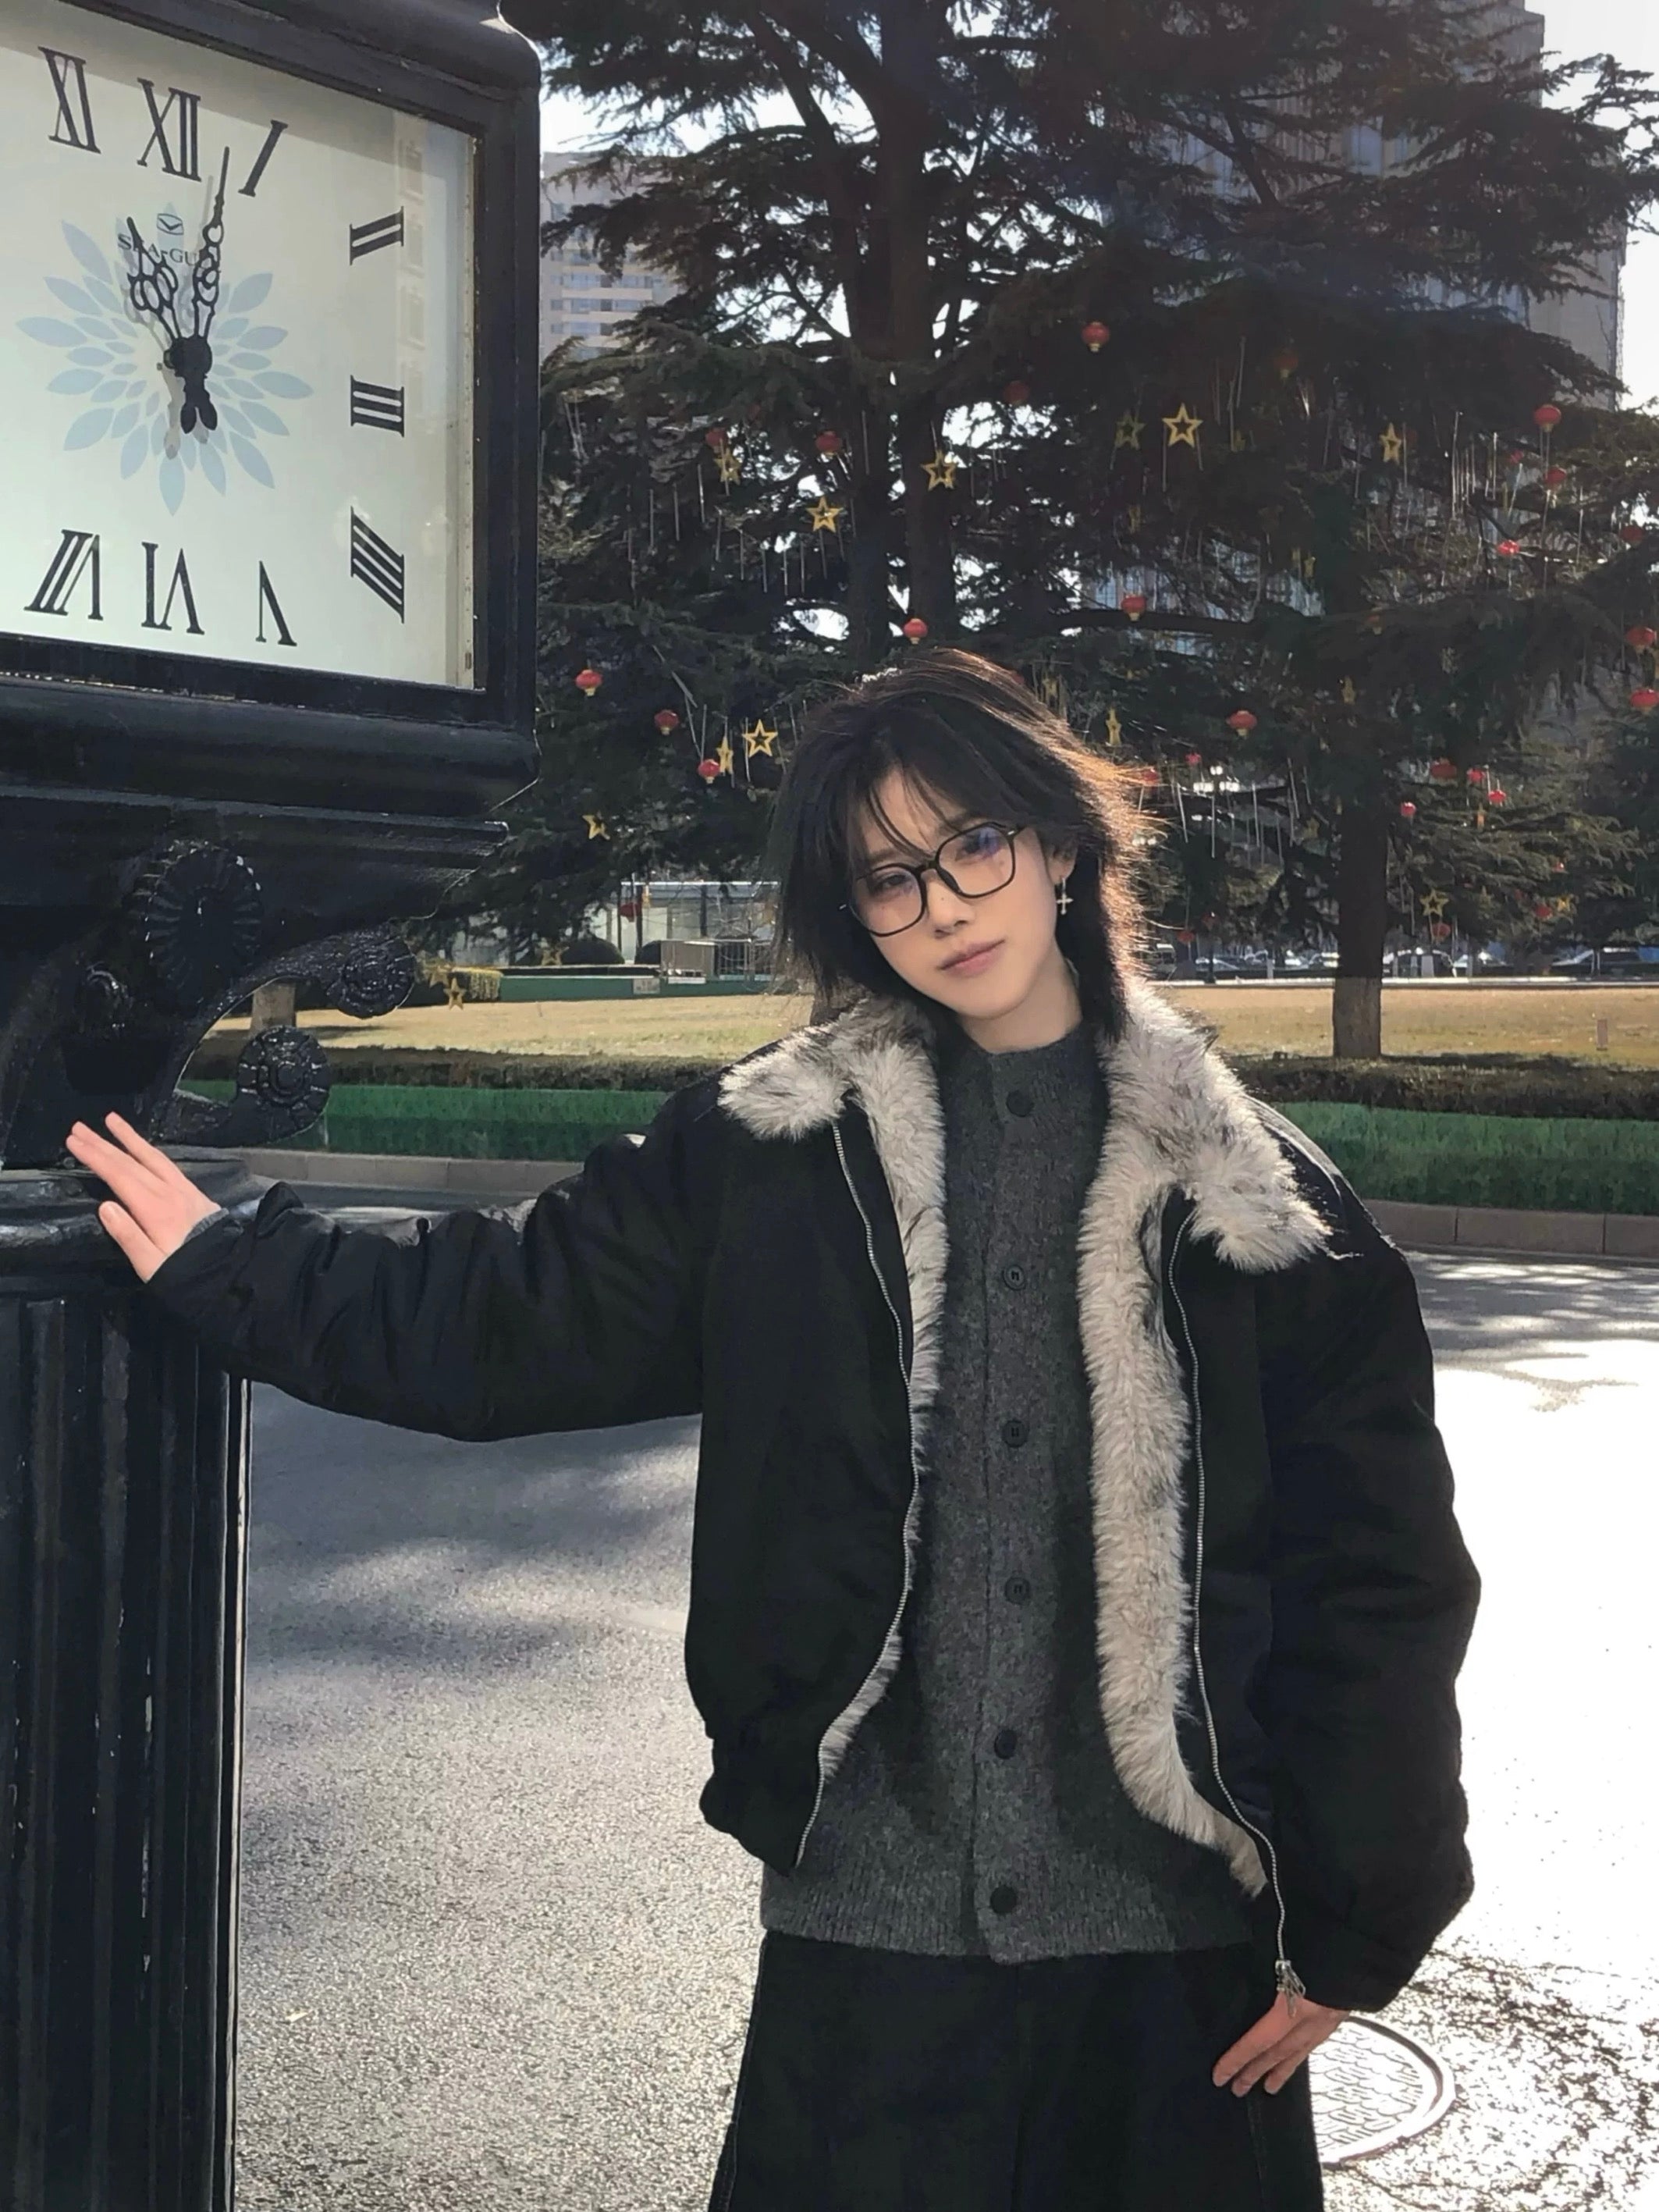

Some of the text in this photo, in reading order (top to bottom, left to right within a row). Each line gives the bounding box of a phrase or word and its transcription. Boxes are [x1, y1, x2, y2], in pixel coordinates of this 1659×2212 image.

[37, 46, 101, 153] XI
[137, 77, 201, 181] XII
[239, 120, 288, 197] I
[350, 205, 404, 265] II
[350, 375, 405, 437] III
[24, 529, 103, 621] VII
[141, 542, 204, 635] VI
[256, 560, 297, 646] V
[350, 506, 405, 624] IIII
